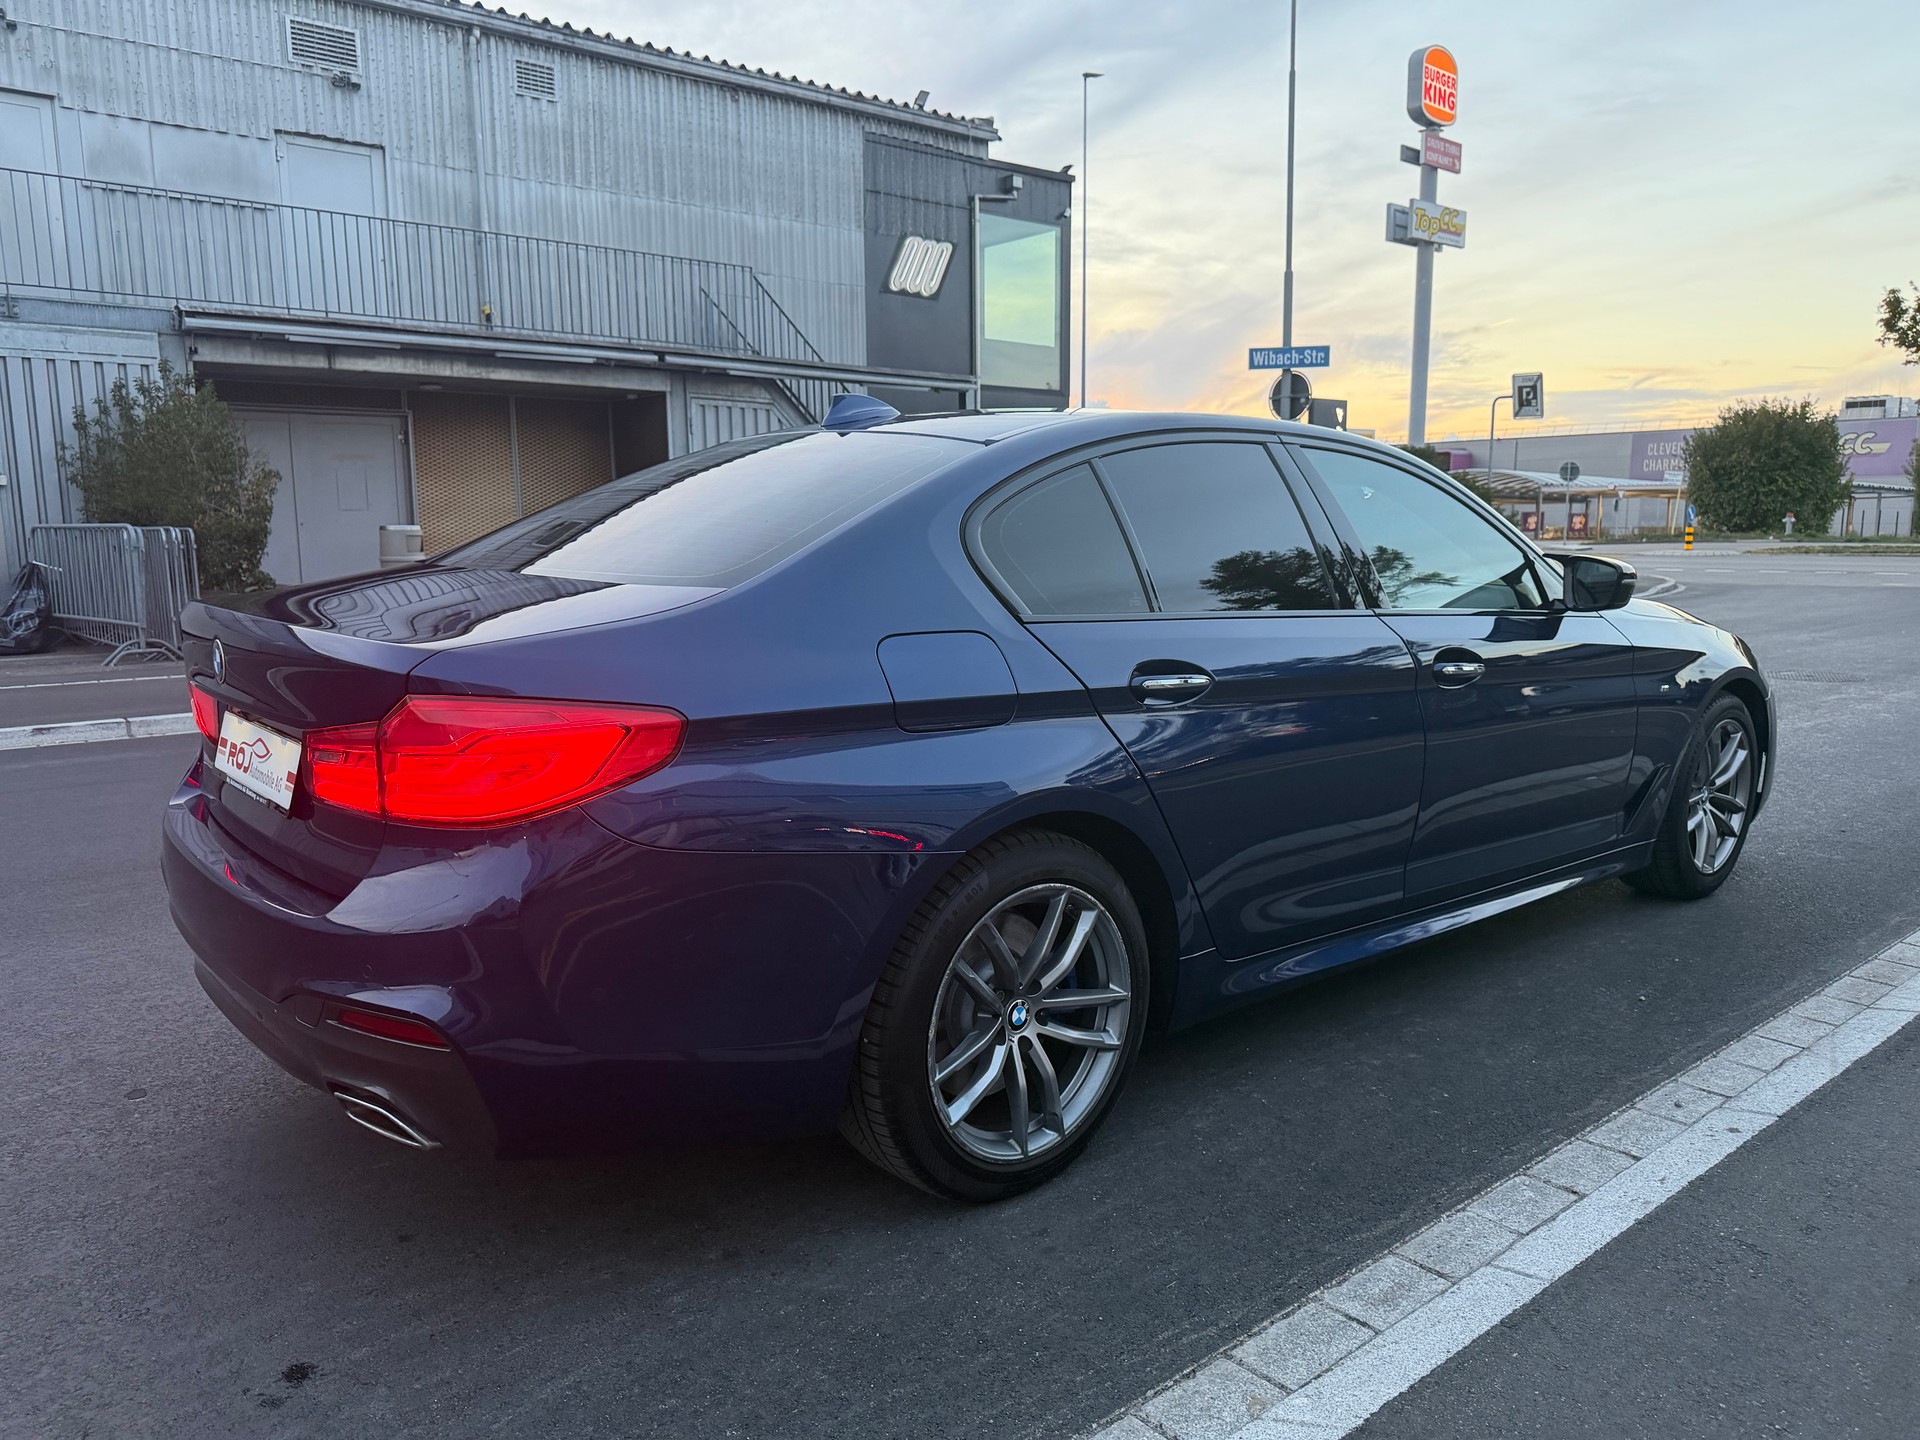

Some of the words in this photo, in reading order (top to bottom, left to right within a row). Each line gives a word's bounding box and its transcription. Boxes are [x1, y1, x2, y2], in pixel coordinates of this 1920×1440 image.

[1425, 66, 1456, 91] BURGER
[1424, 81, 1455, 111] KING
[1253, 349, 1325, 366] Wibach-Str.
[227, 741, 253, 774] ROJ
[273, 772, 283, 793] AG
